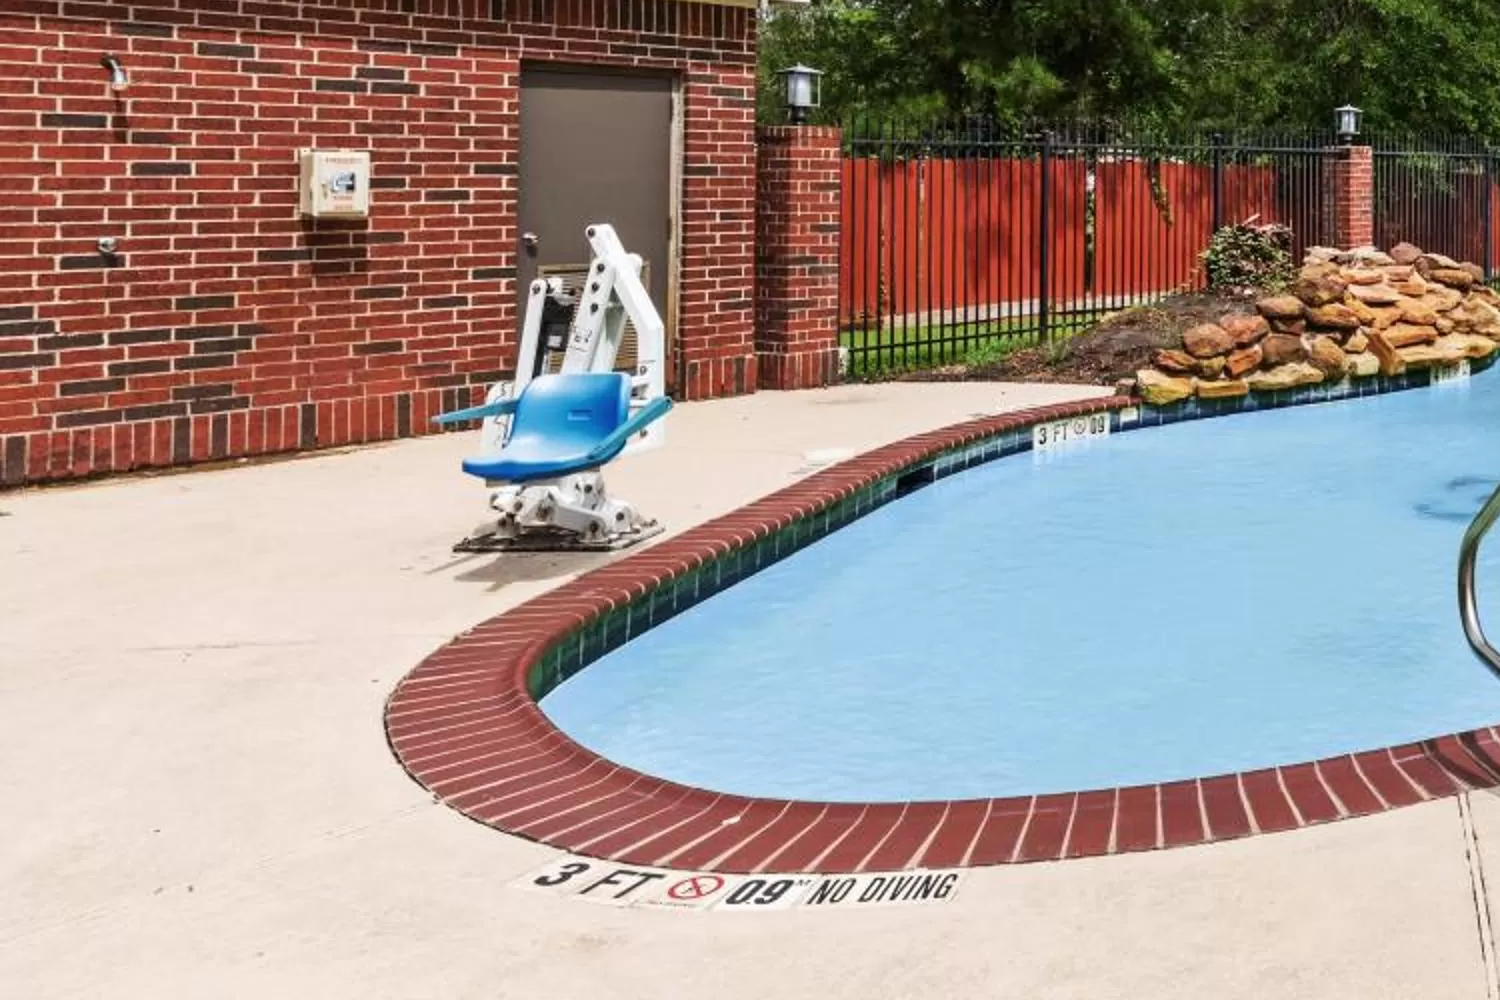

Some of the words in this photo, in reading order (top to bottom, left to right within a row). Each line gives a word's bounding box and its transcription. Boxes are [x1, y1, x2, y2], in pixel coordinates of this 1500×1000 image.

[1039, 427, 1047, 445] 3
[1054, 421, 1069, 442] FT
[534, 863, 590, 886] 3
[579, 869, 666, 899] FT
[806, 878, 857, 905] NO
[857, 873, 959, 903] DIVING
